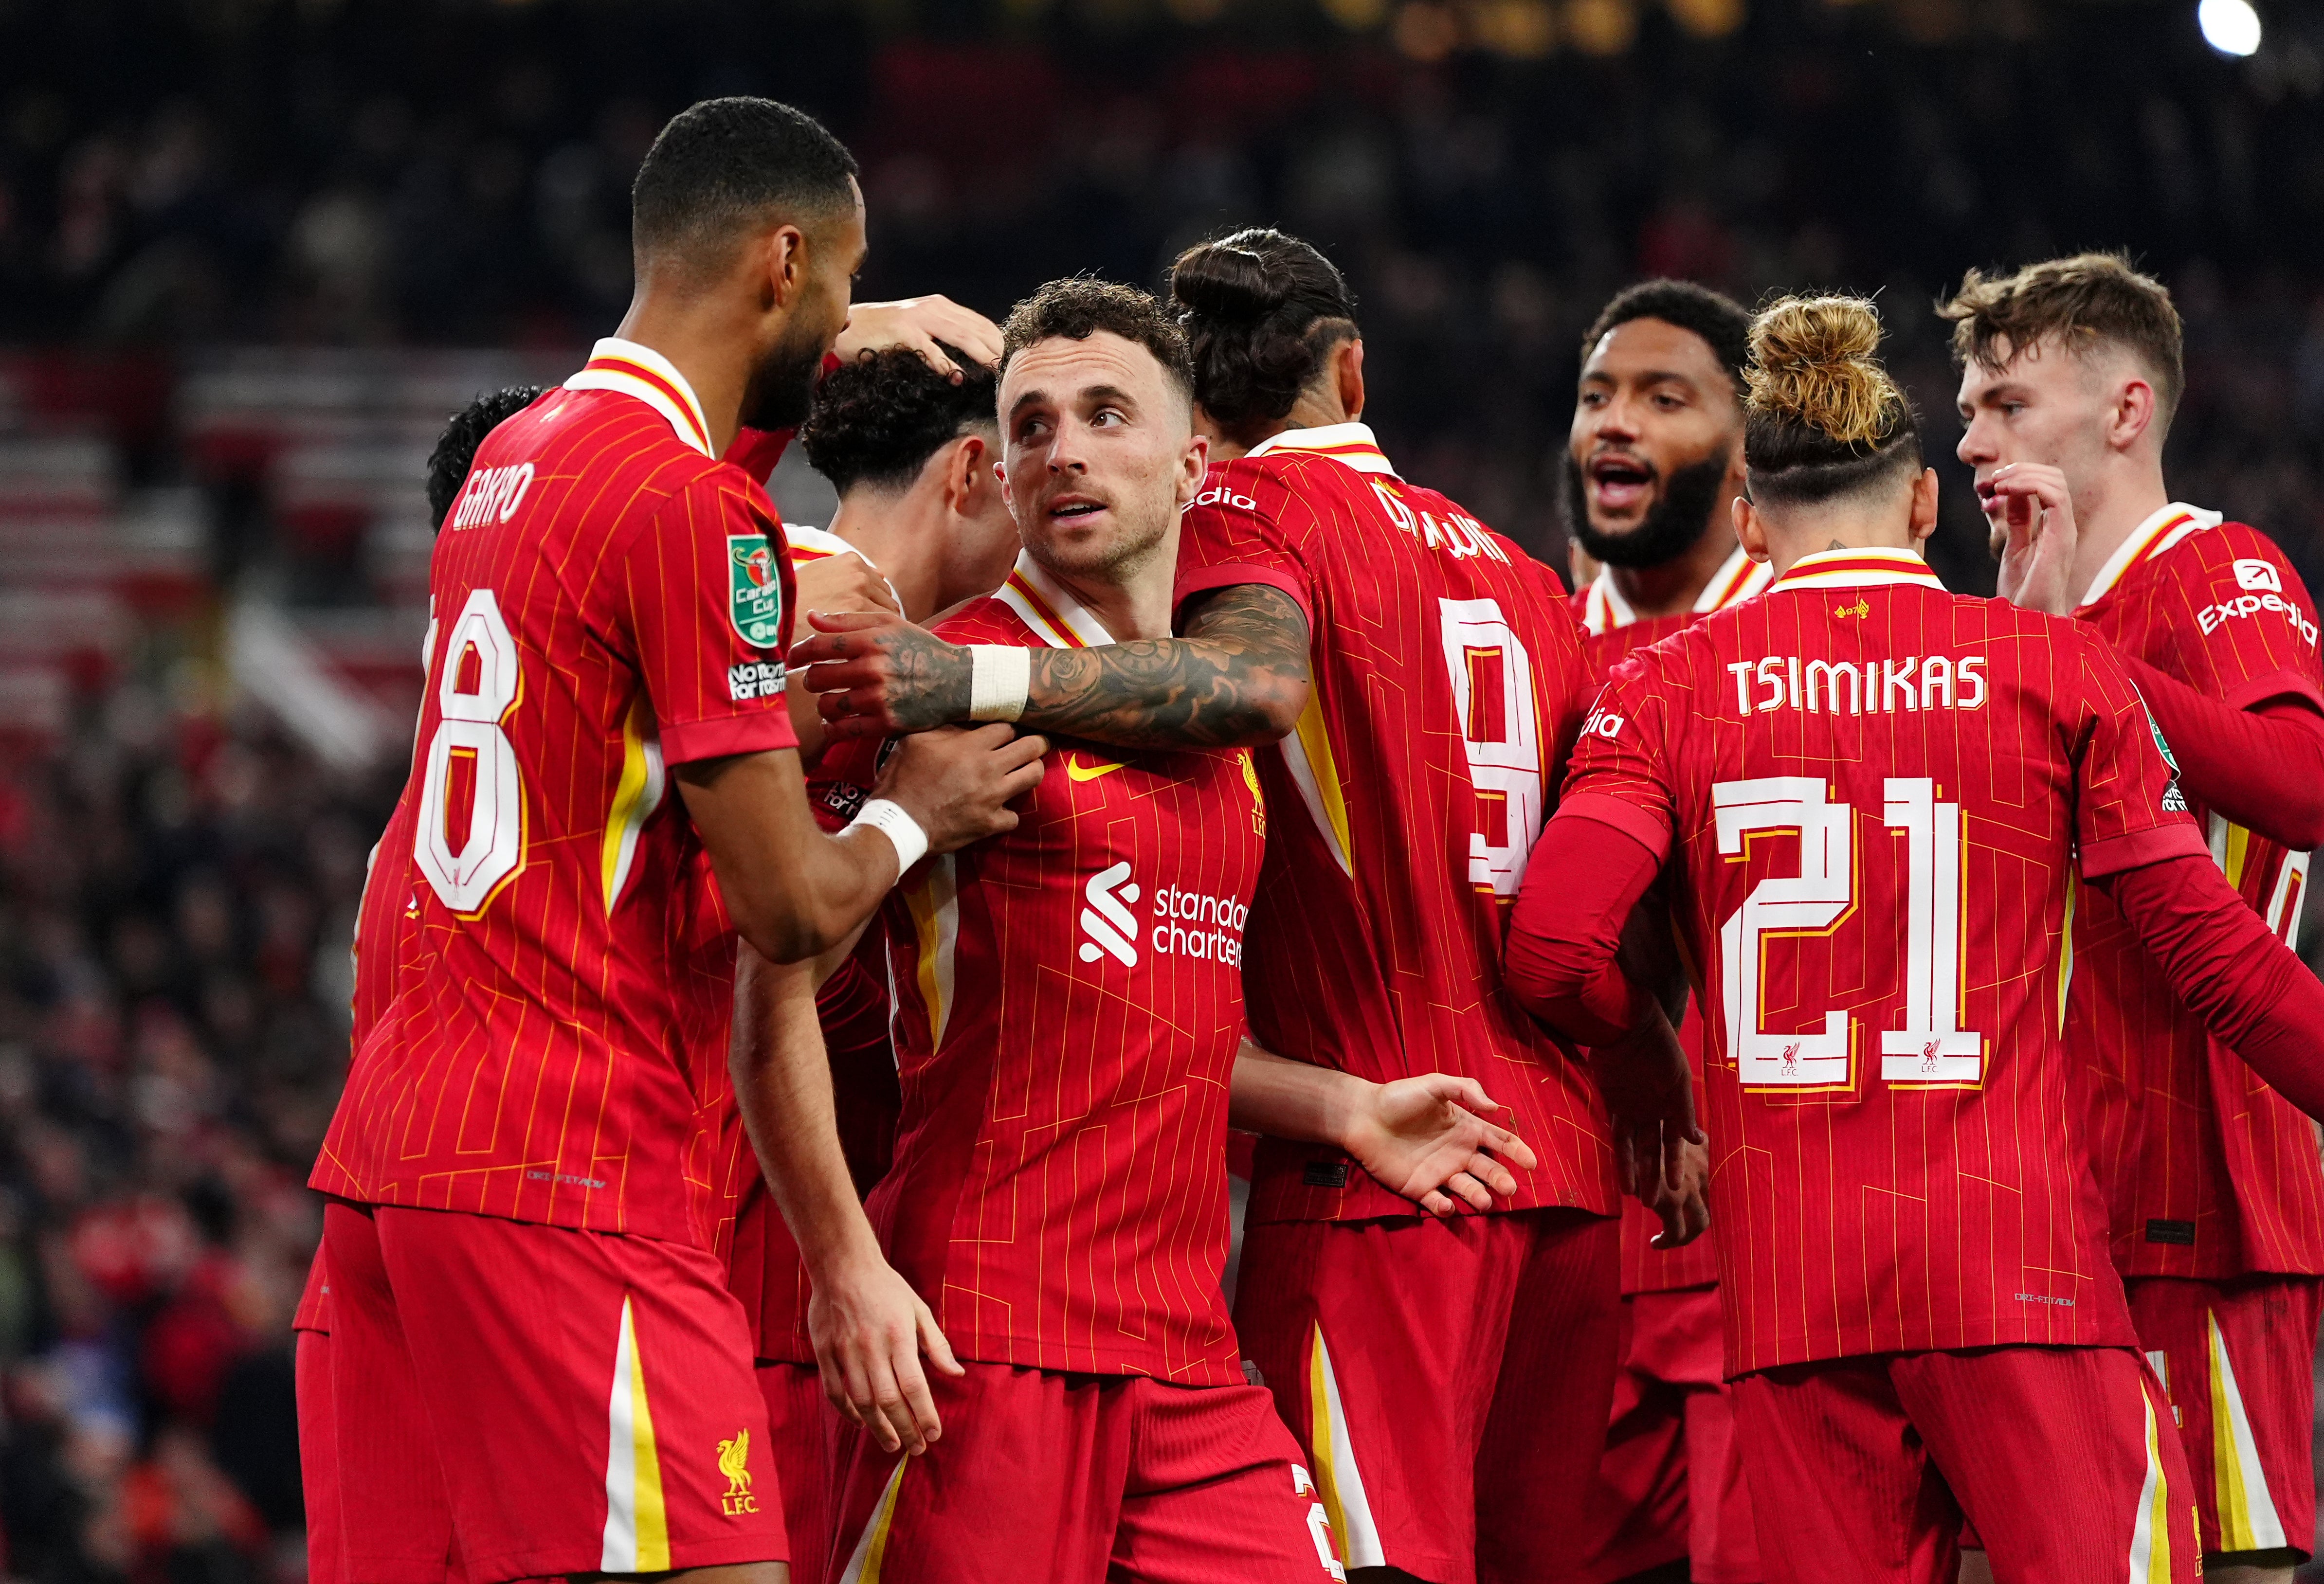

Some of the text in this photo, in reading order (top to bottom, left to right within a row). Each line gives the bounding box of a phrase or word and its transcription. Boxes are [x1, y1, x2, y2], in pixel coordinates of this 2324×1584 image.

[453, 462, 535, 531] GAKPO
[728, 664, 758, 683] No
[729, 681, 758, 701] for
[1727, 656, 1987, 717] TSIMIKAS
[405, 589, 527, 920] 8
[1438, 597, 1543, 900] 9
[1712, 777, 1989, 1090] 21
